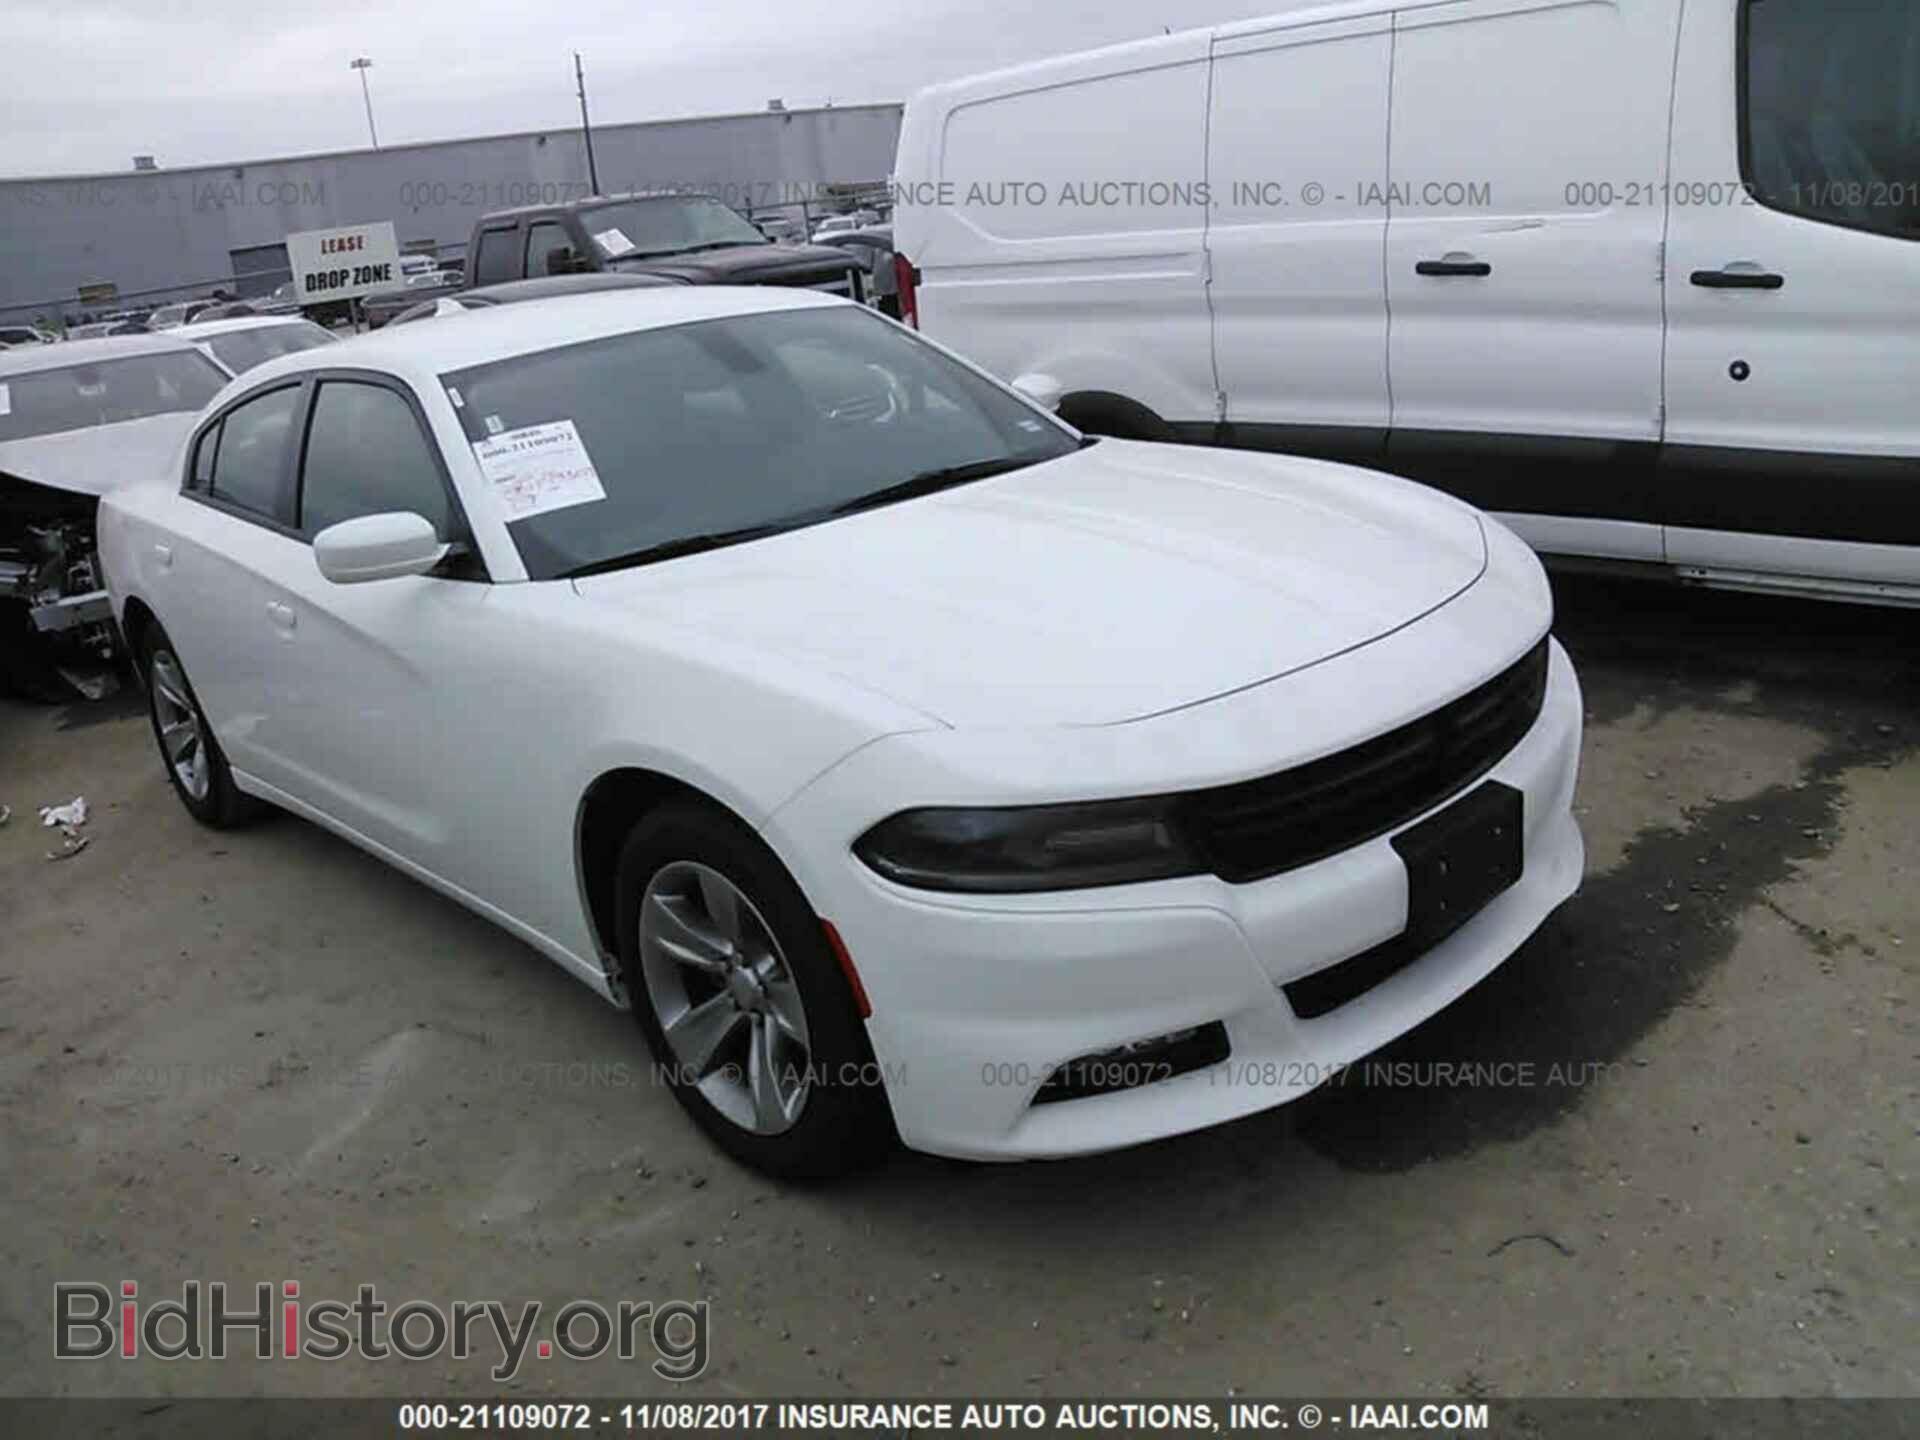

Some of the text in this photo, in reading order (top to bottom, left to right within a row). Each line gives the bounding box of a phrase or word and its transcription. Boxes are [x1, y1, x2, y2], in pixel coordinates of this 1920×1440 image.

[321, 235, 363, 255] LEASE
[305, 263, 392, 292] DROP ZONE
